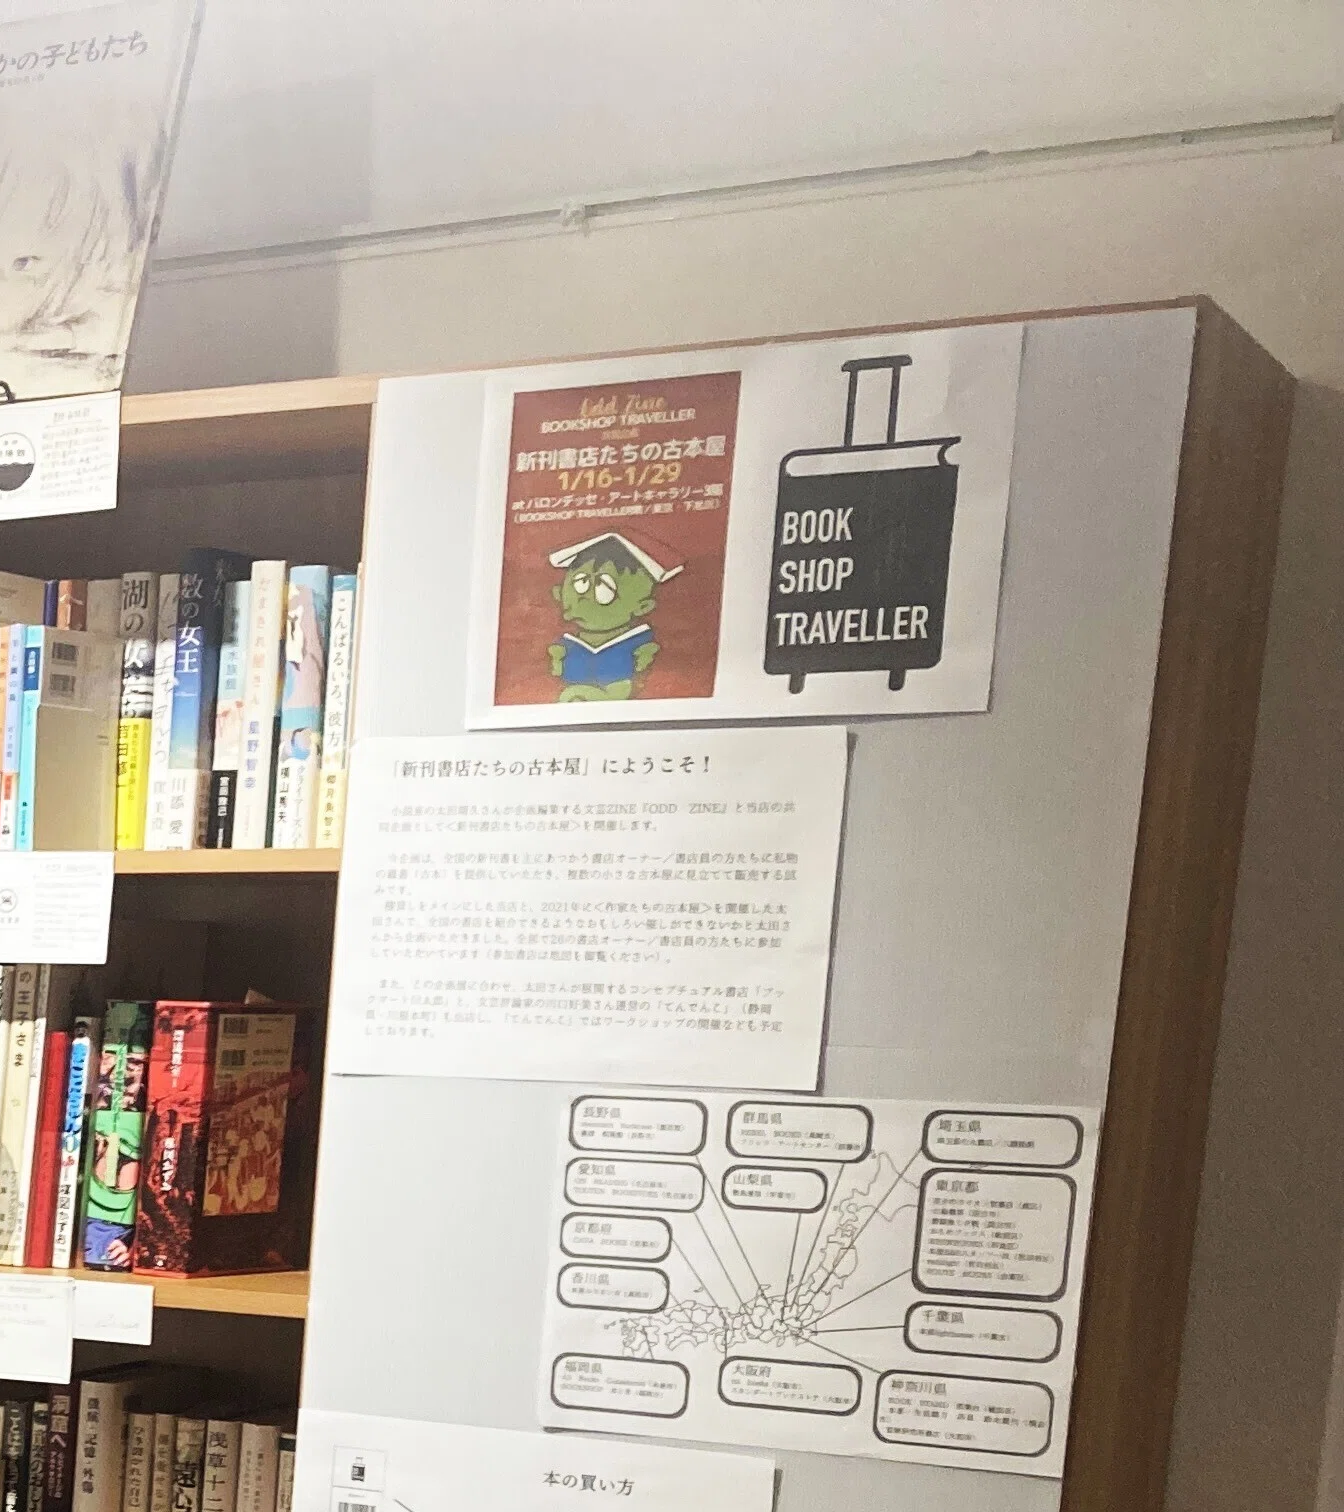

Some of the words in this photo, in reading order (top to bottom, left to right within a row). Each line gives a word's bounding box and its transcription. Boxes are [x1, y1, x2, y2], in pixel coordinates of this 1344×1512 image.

[541, 414, 616, 434] BOOKSHOP
[620, 407, 696, 427] TRAVELLER
[515, 434, 727, 473] 新刊書店たちの古本屋
[557, 461, 682, 492] 1/16-1/29
[782, 507, 853, 545] BOOK
[779, 557, 854, 595] SHOP
[176, 574, 205, 674] 数の女王
[775, 604, 930, 648] TRAVELLER
[325, 597, 351, 748] こんぱるいろ、彼方
[244, 720, 261, 788] 星野智幸
[169, 775, 187, 836] 川添愛
[542, 1470, 635, 1496] 本の買い方
